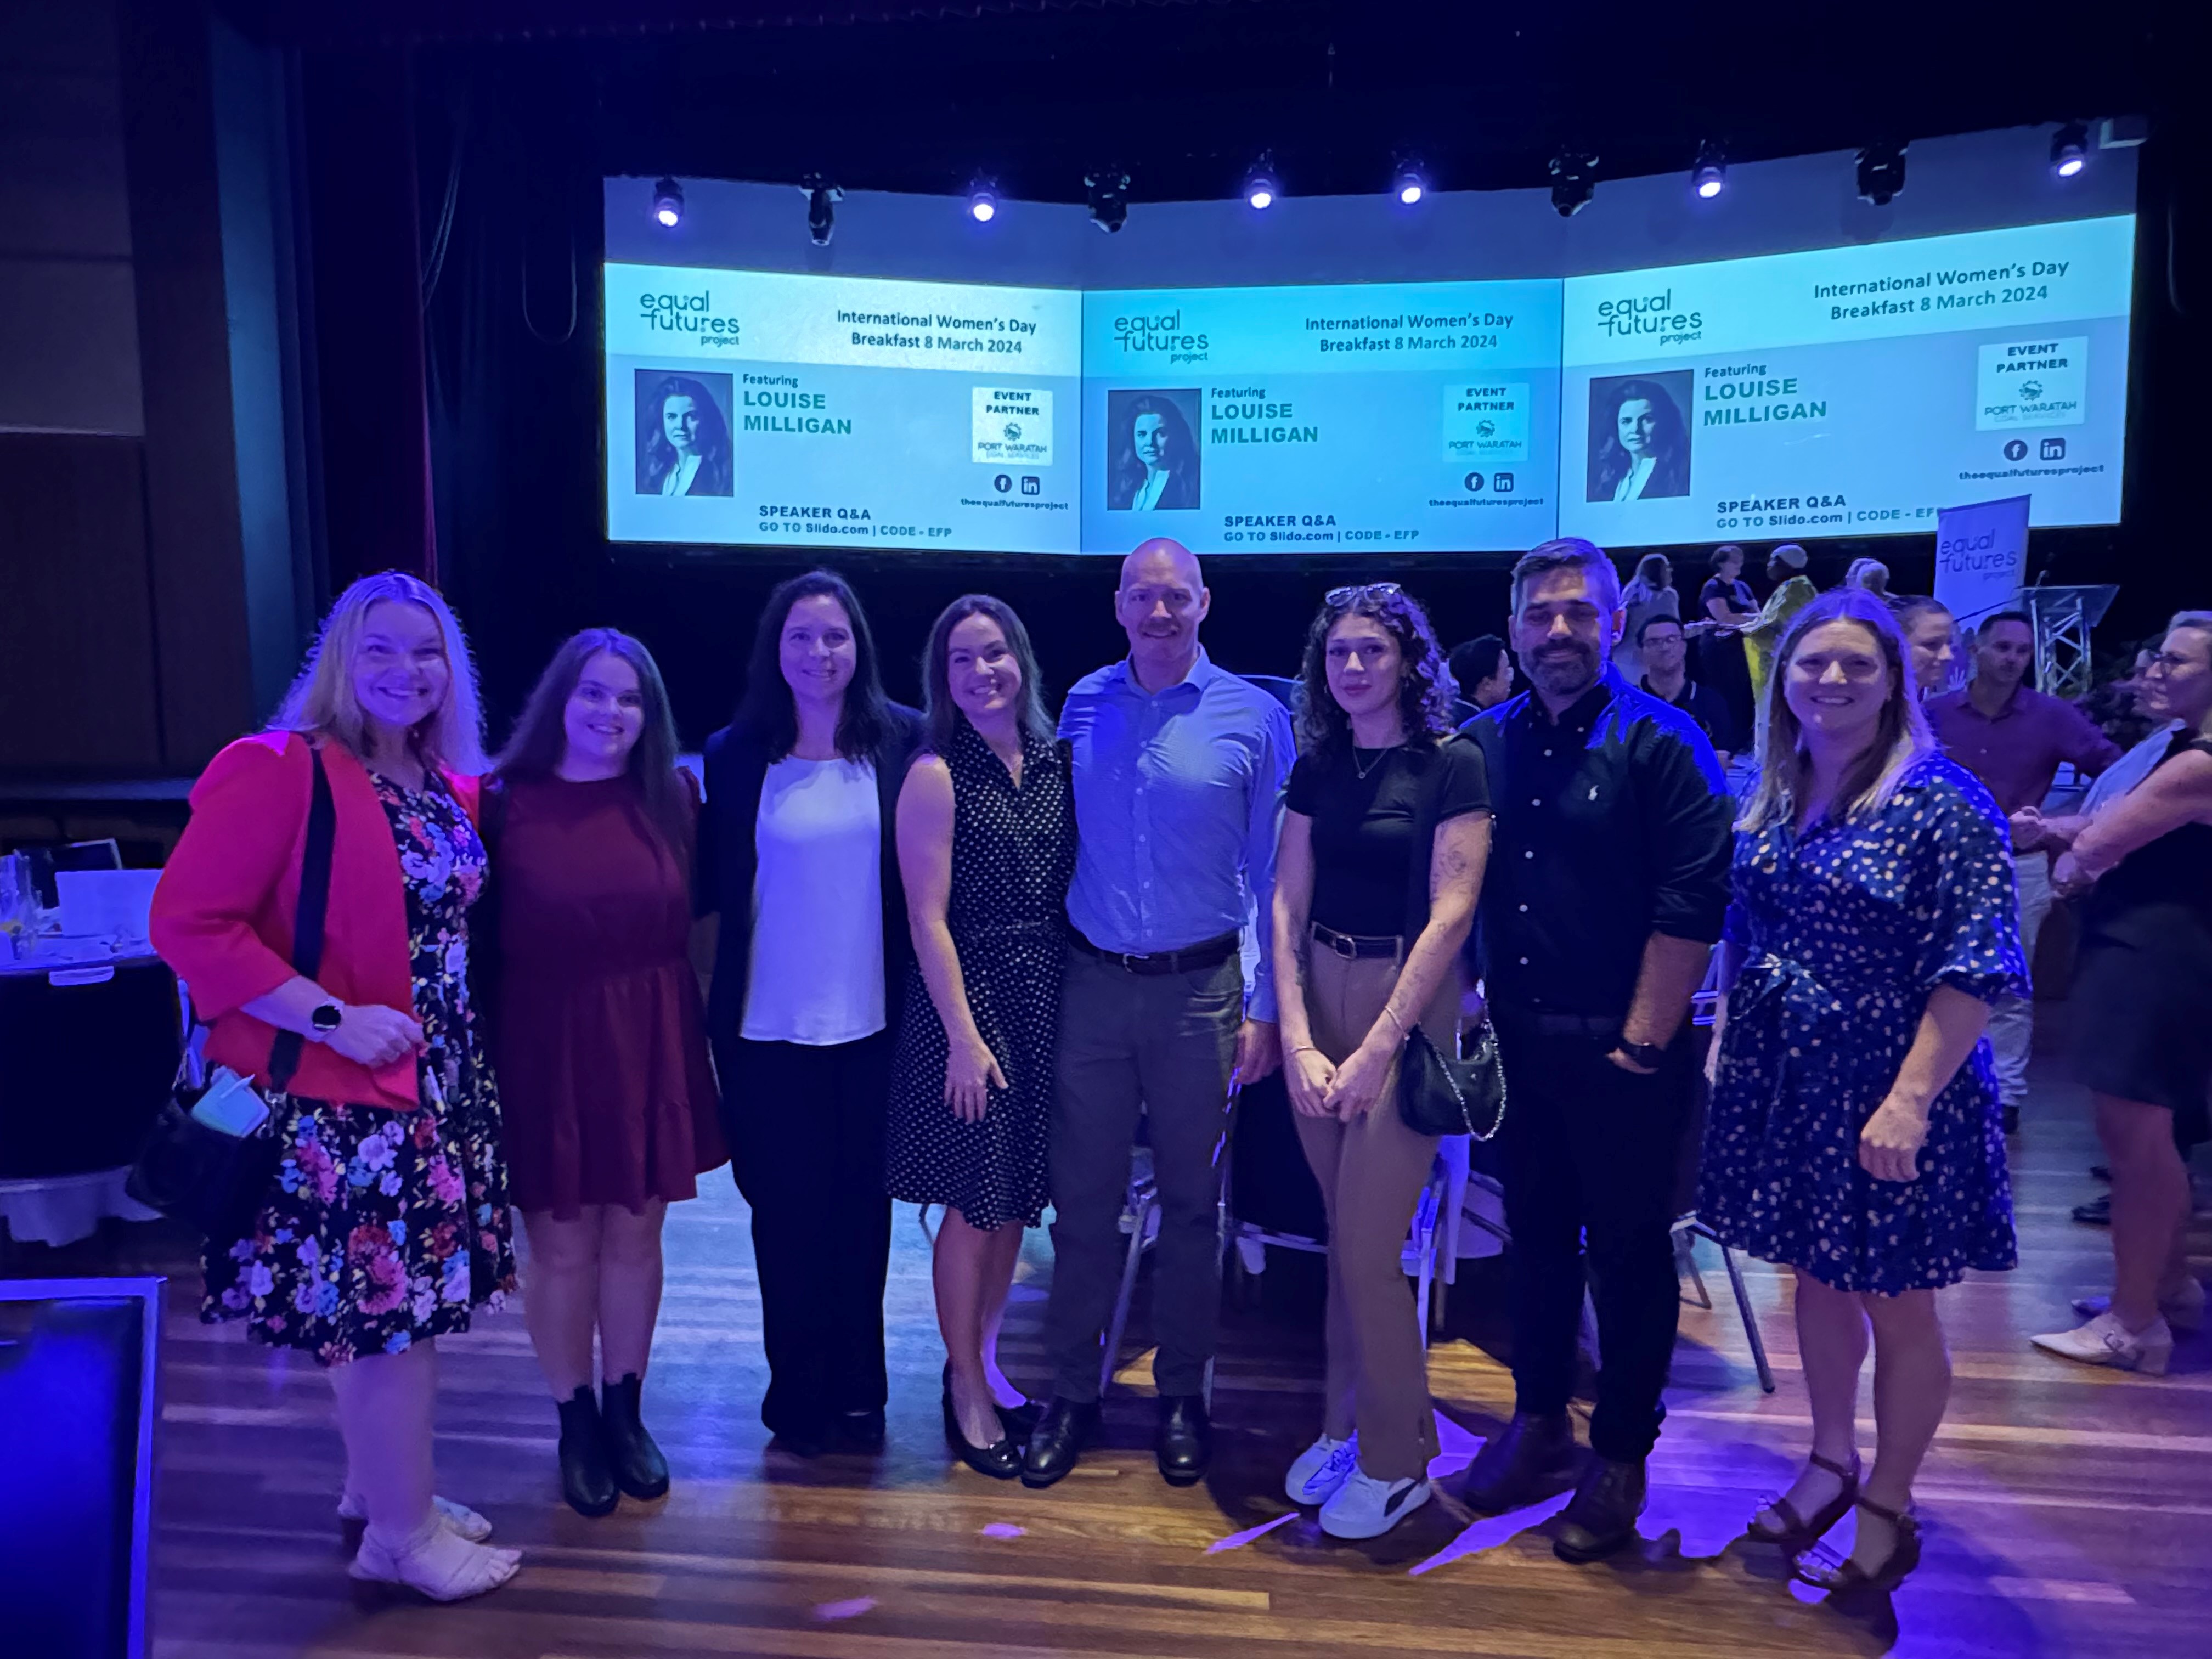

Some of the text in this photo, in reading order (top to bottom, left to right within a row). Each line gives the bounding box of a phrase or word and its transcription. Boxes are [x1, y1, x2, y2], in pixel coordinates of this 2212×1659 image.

[1814, 261, 2069, 298] International Women’s Day
[640, 290, 709, 316] equal
[1598, 288, 1671, 320] equal
[1831, 285, 2047, 320] Breakfast 8 March 2024
[640, 308, 740, 334] futures
[837, 309, 1037, 336] International Women’s Day
[1115, 308, 1180, 337] equal
[1306, 312, 1513, 330] International Women’s Day
[1598, 312, 1703, 337] futures
[701, 335, 740, 348] project
[851, 332, 1022, 354] Breakfast 8 March 2024
[1114, 330, 1209, 352] futures
[1320, 335, 1497, 352] Breakfast 8 March 2024
[1659, 330, 1702, 346] project
[1170, 351, 1208, 364] project
[2008, 343, 2059, 357] EVENT
[1704, 363, 1767, 378] Featuring
[1996, 358, 2068, 373] PARTNER
[743, 373, 799, 388] Featuring
[1705, 377, 1797, 400] LOUISE
[744, 391, 826, 409] LOUISE
[994, 391, 1031, 401] EVENT
[1211, 386, 1266, 399] Featuring
[1466, 387, 1506, 397] EVENT
[986, 405, 1039, 415] PARTNER
[1211, 403, 1293, 420] LOUISE
[1458, 402, 1514, 411] PARTNER
[1703, 401, 1827, 426] MILLIGAN
[1984, 401, 2077, 415] PORT WARATAH
[744, 415, 851, 434] MILLIGAN
[1211, 426, 1318, 444] MILLIGAN
[978, 442, 1047, 453] PORT WARATAH
[1448, 440, 1522, 449] PORT WARATAH
[759, 505, 871, 520] SPEAKER Q&A
[1717, 495, 1847, 514] SPEAKER Q&A
[1224, 515, 1336, 527] SPEAKER Q&A
[1716, 517, 1738, 528] GO
[1743, 517, 1764, 527] TO
[1769, 514, 1843, 526] Slido.com
[1857, 509, 1900, 522] CODE
[1916, 507, 1940, 518] EF
[759, 521, 779, 532] GO
[783, 522, 802, 533] TO
[806, 523, 869, 534] Slido.com
[880, 526, 916, 536] CODE
[928, 527, 952, 537] EFP
[1224, 531, 1244, 541] GO
[1247, 531, 1266, 541] TO
[1269, 531, 1334, 541] Slido.com
[1345, 530, 1381, 540] CODE
[1394, 530, 1419, 540] EFP
[1940, 528, 1995, 557] equal
[1939, 550, 2017, 573] futures
